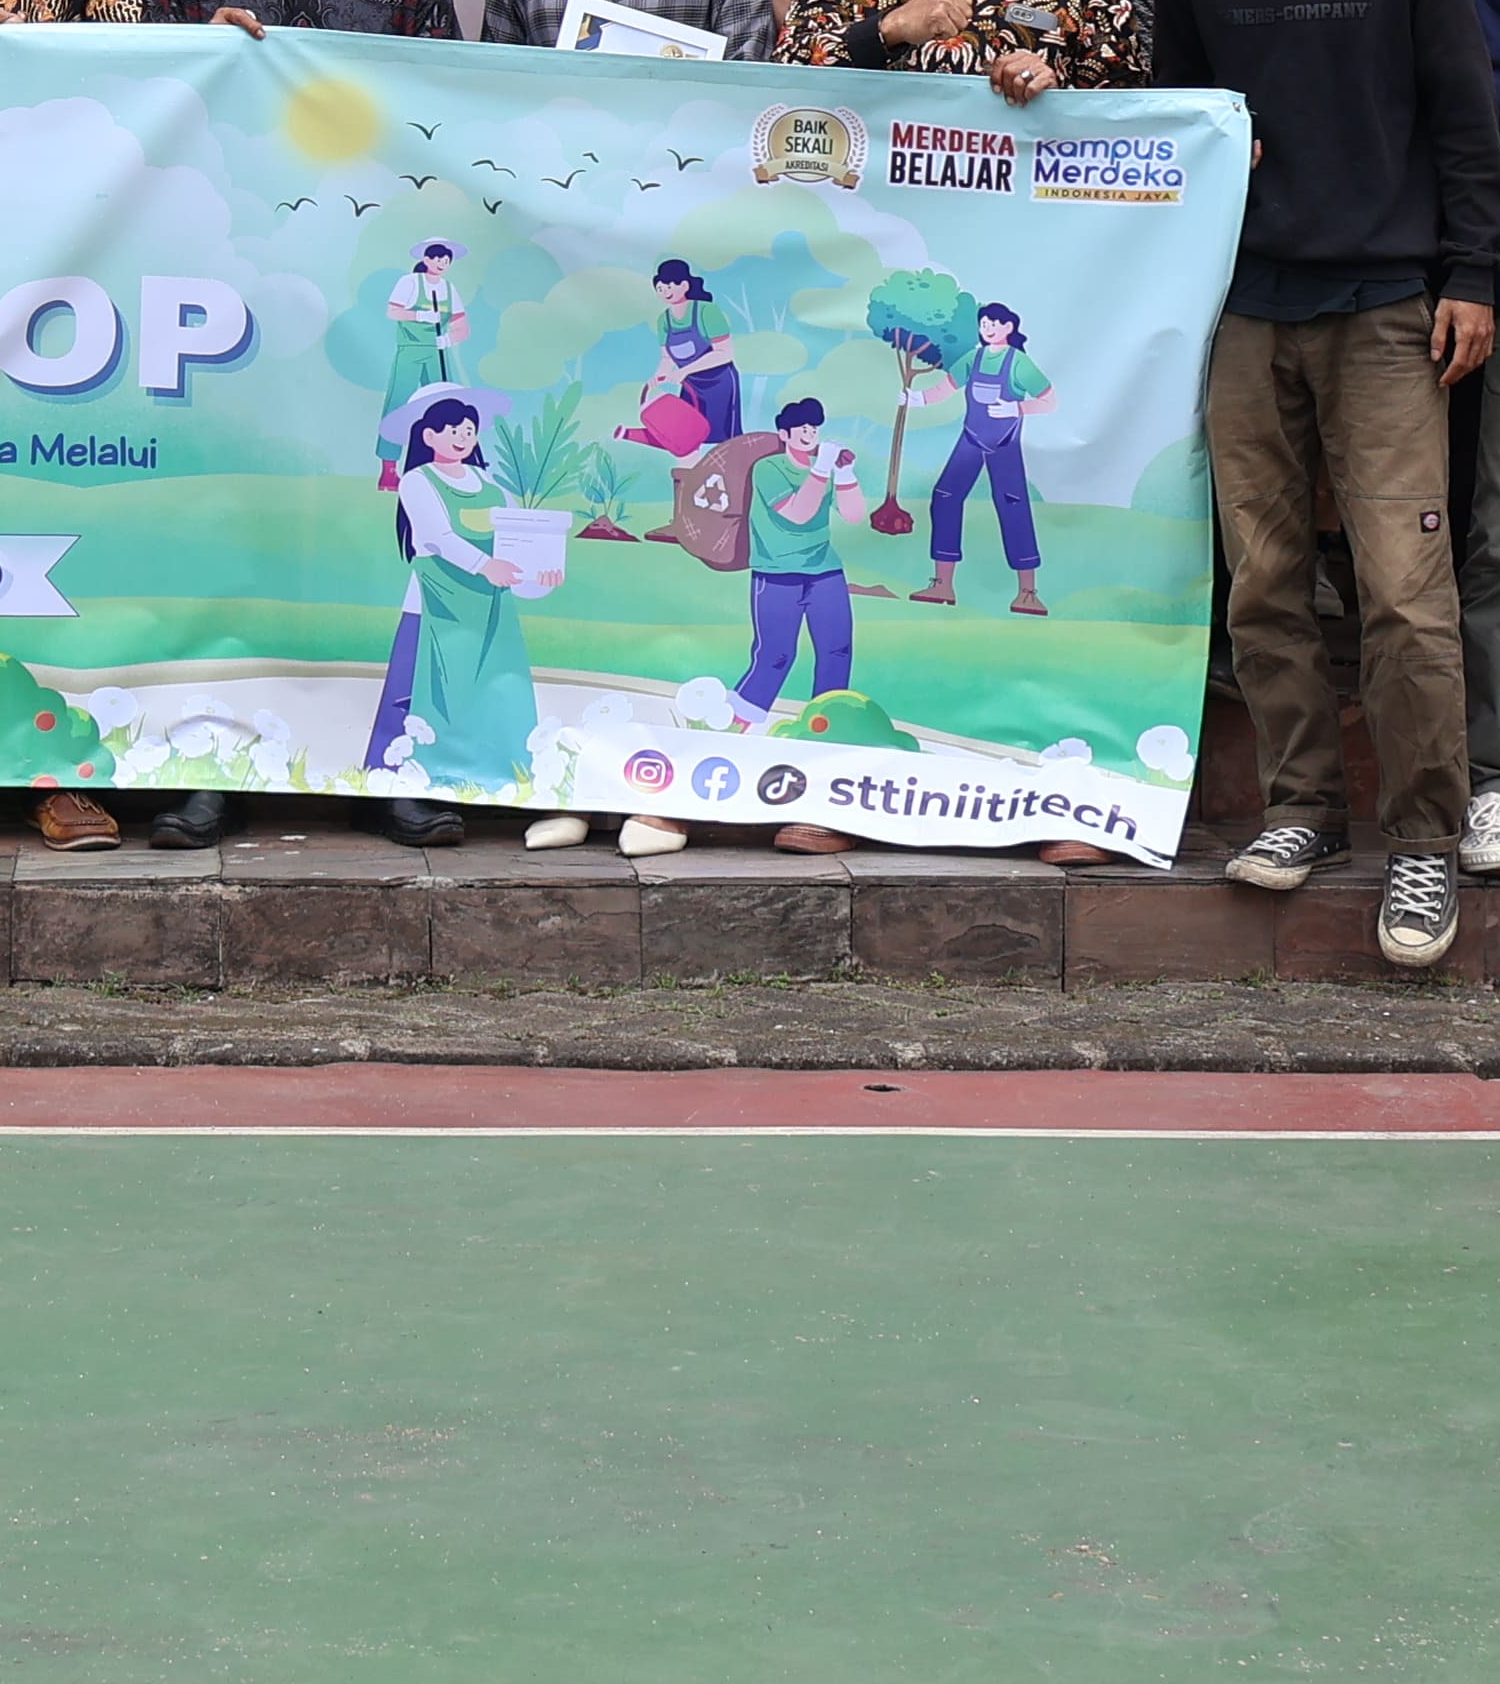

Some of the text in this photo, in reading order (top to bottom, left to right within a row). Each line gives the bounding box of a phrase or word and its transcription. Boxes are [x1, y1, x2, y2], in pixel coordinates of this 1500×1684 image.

[793, 119, 829, 135] BAIK
[892, 122, 1015, 157] MERDEKA
[784, 136, 834, 155] SEKALI
[1036, 138, 1174, 164] Kampus
[785, 160, 829, 172] AKREDITASI
[889, 152, 1012, 192] BELAJAR
[1034, 158, 1183, 187] Merdeka
[1045, 188, 1172, 201] INDONESIA JAYA
[30, 432, 158, 470] Melalui
[828, 775, 1138, 841] sttiniititech
